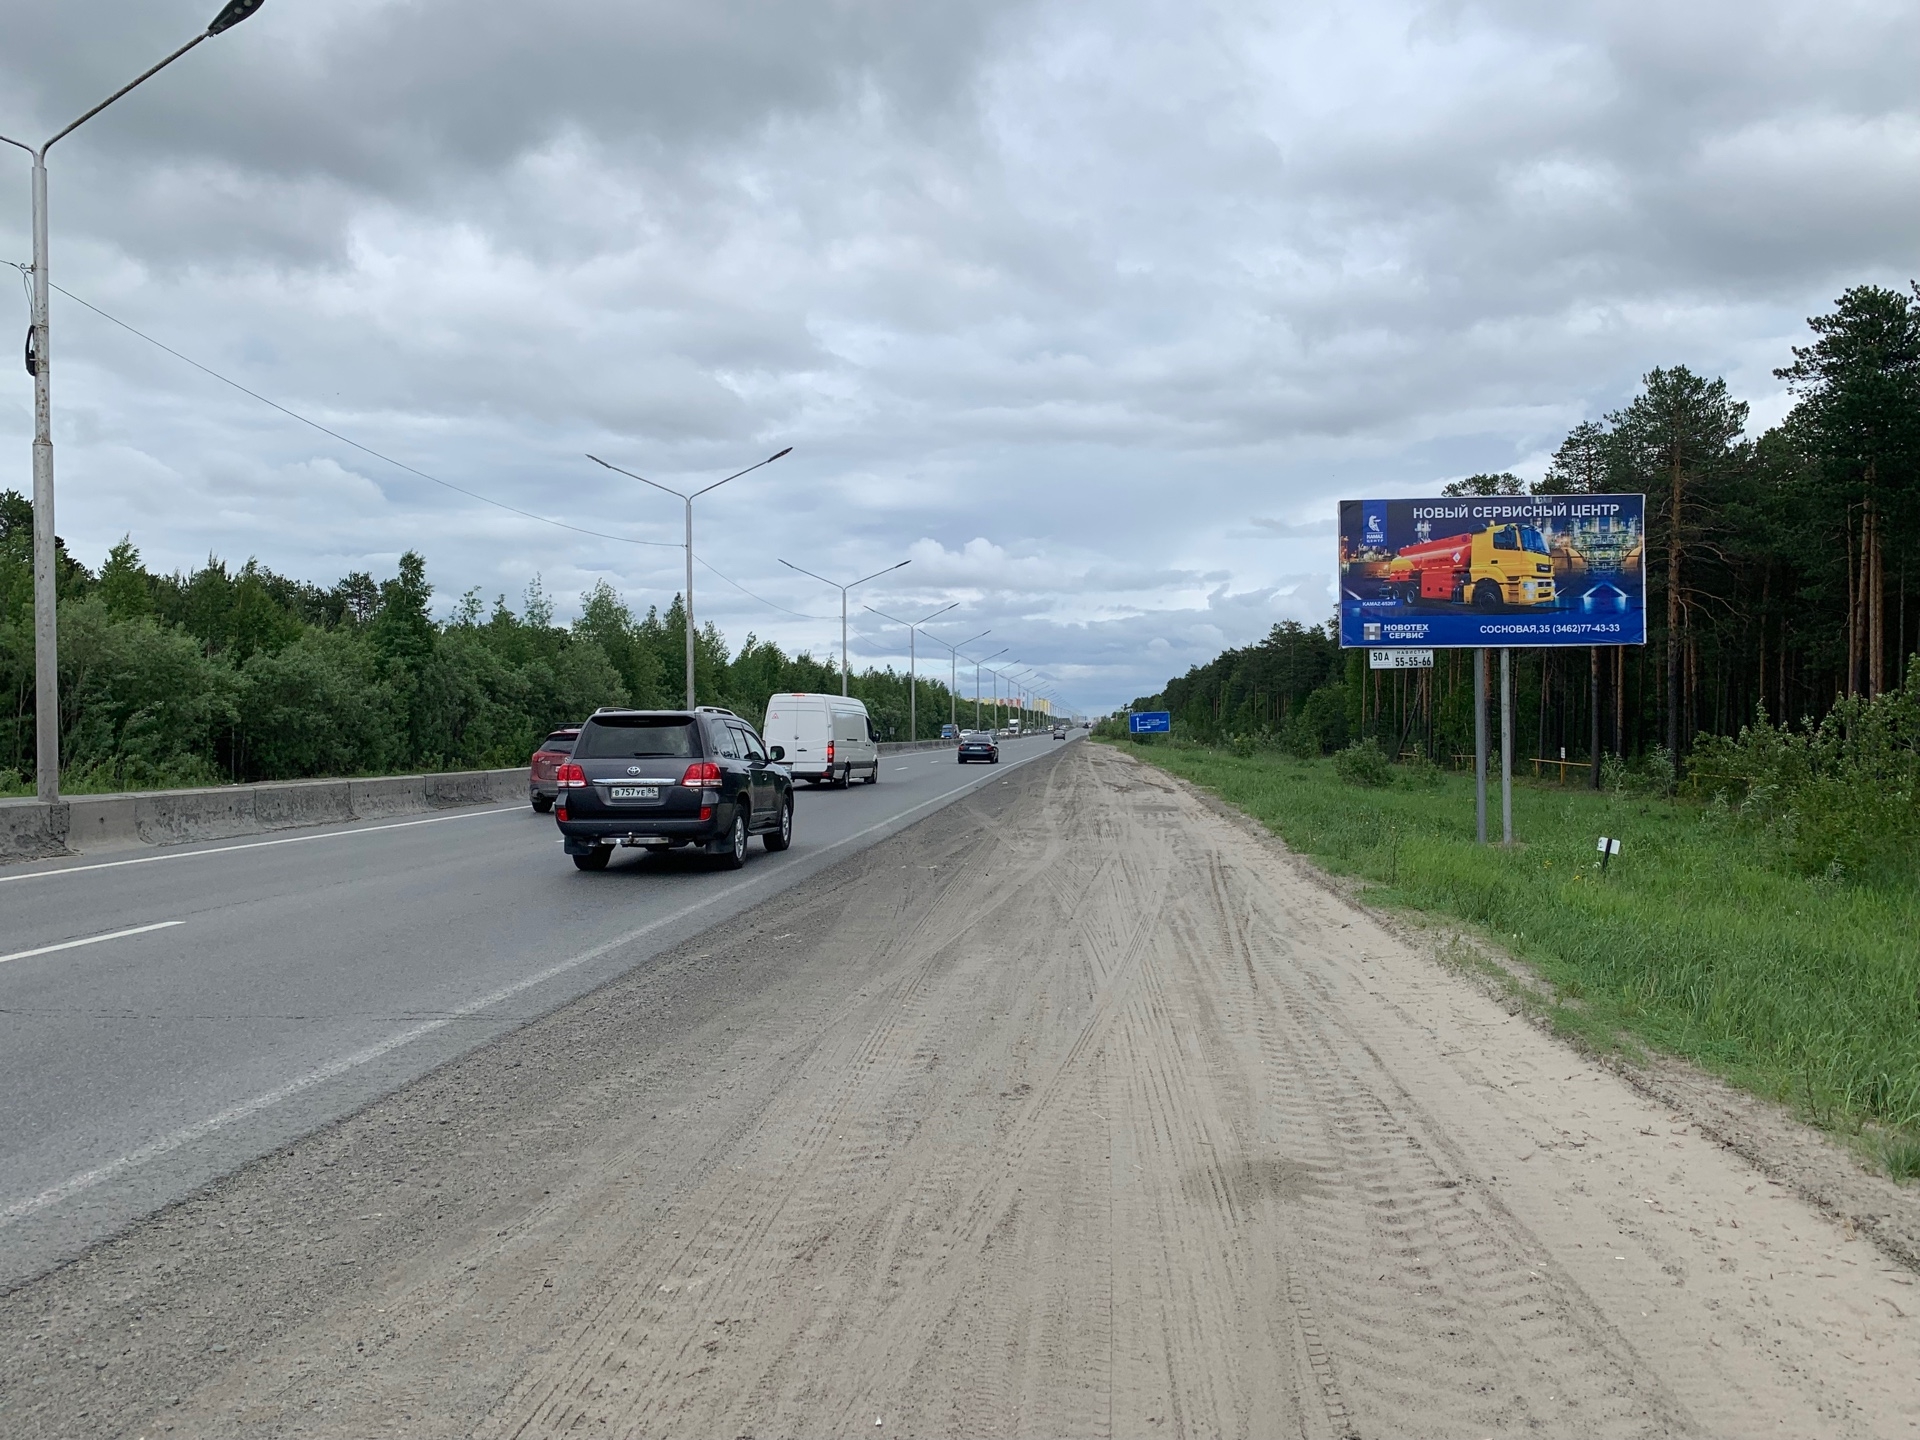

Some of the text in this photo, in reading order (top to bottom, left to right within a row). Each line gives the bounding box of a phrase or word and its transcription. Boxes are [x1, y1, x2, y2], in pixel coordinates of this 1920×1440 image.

[1413, 502, 1620, 519] НОВЫЙ СЕРВИСНЫЙ ЦЕНТР
[1395, 656, 1432, 667] 55-55-66
